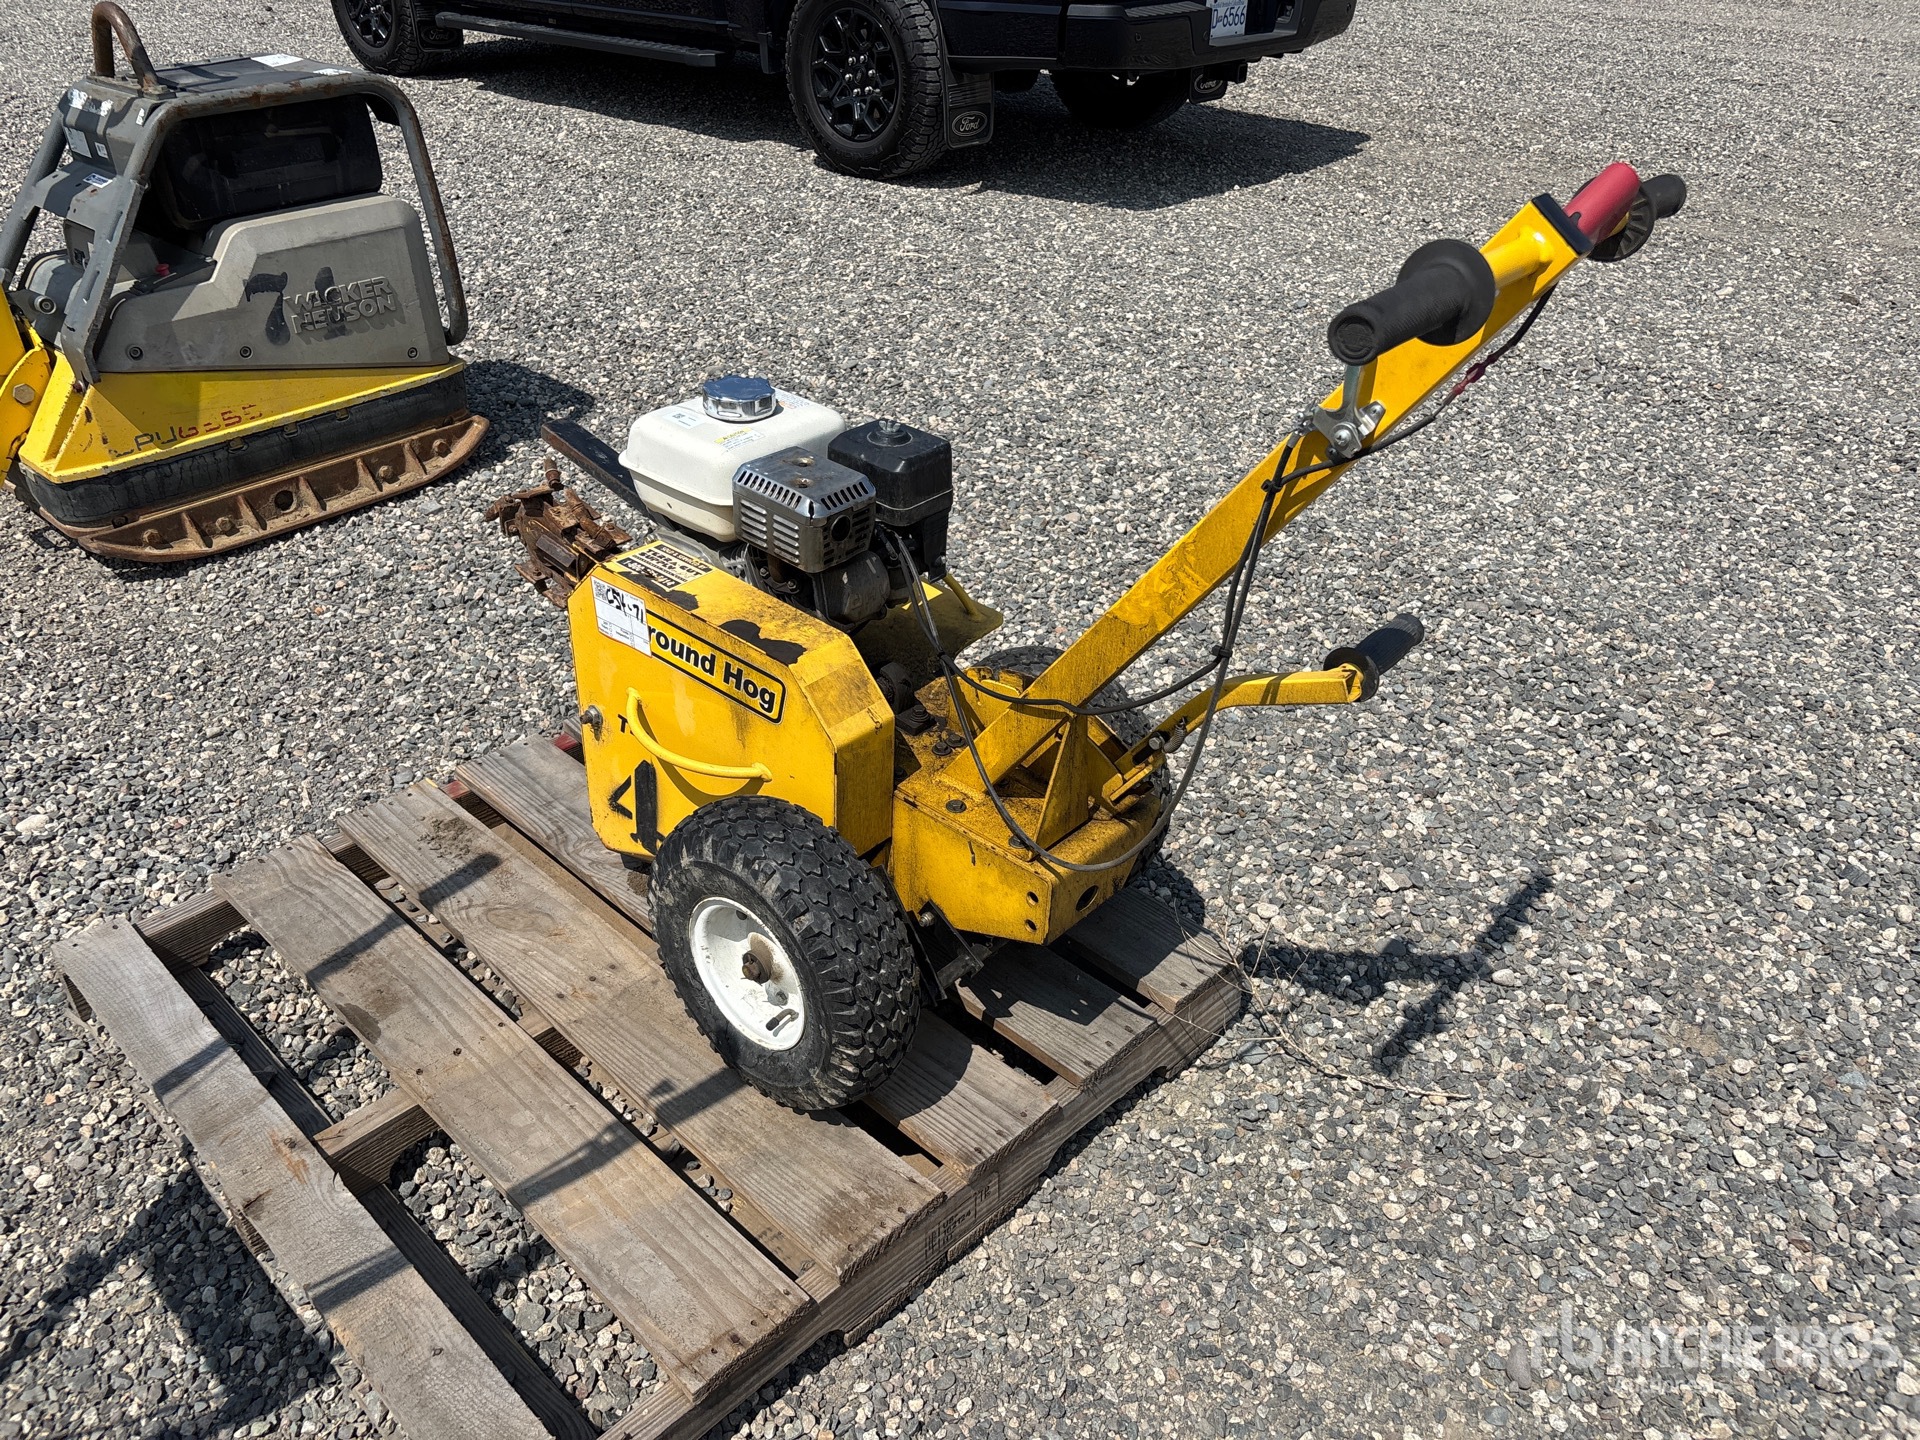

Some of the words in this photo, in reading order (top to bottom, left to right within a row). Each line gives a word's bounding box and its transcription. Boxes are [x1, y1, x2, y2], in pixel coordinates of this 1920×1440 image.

[960, 115, 980, 131] Ford
[283, 276, 393, 312] WACKER
[291, 294, 397, 334] NEUSON
[638, 552, 676, 570] SUPPLY
[647, 549, 678, 566] TERRA
[648, 625, 717, 677] round
[723, 661, 776, 714] Hog
